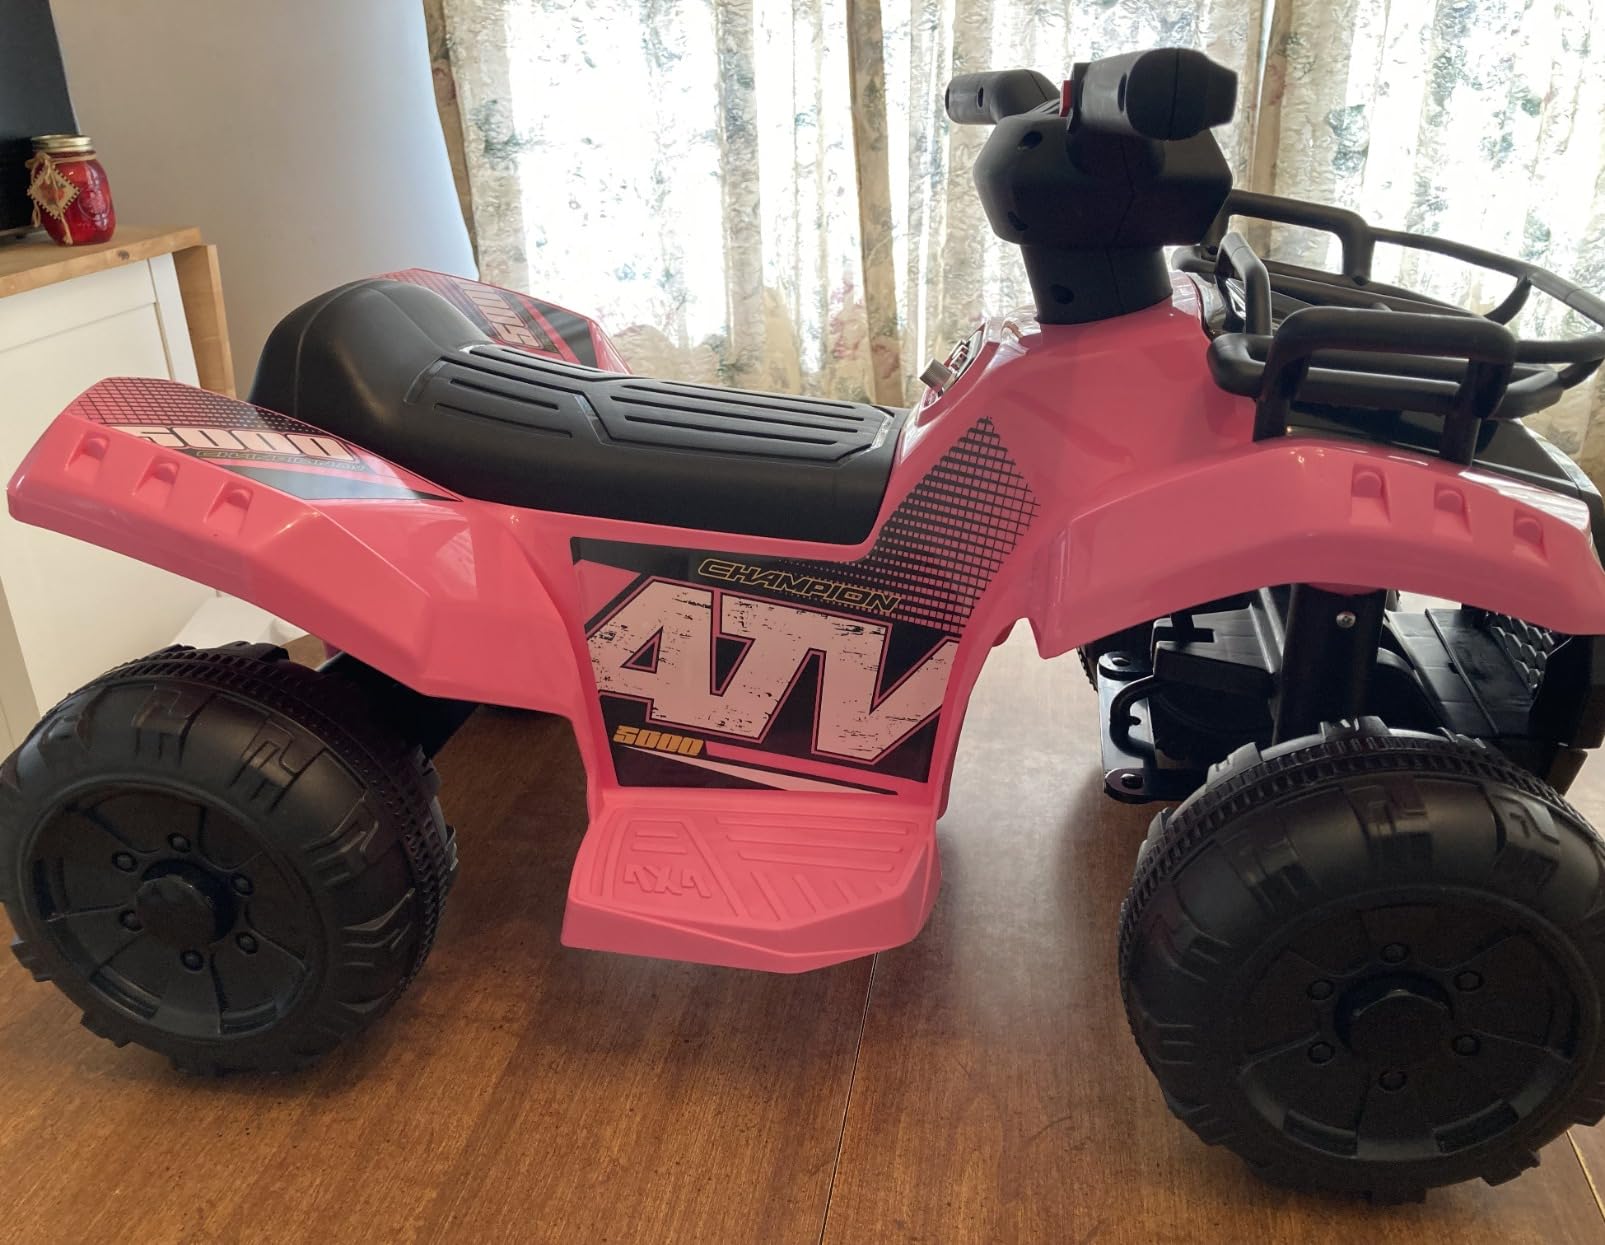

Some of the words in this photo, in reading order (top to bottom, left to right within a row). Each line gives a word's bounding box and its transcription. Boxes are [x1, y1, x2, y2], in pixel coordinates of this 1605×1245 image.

[697, 557, 901, 613] CHAMPION
[586, 578, 962, 763] ATV
[612, 724, 704, 756] 5000
